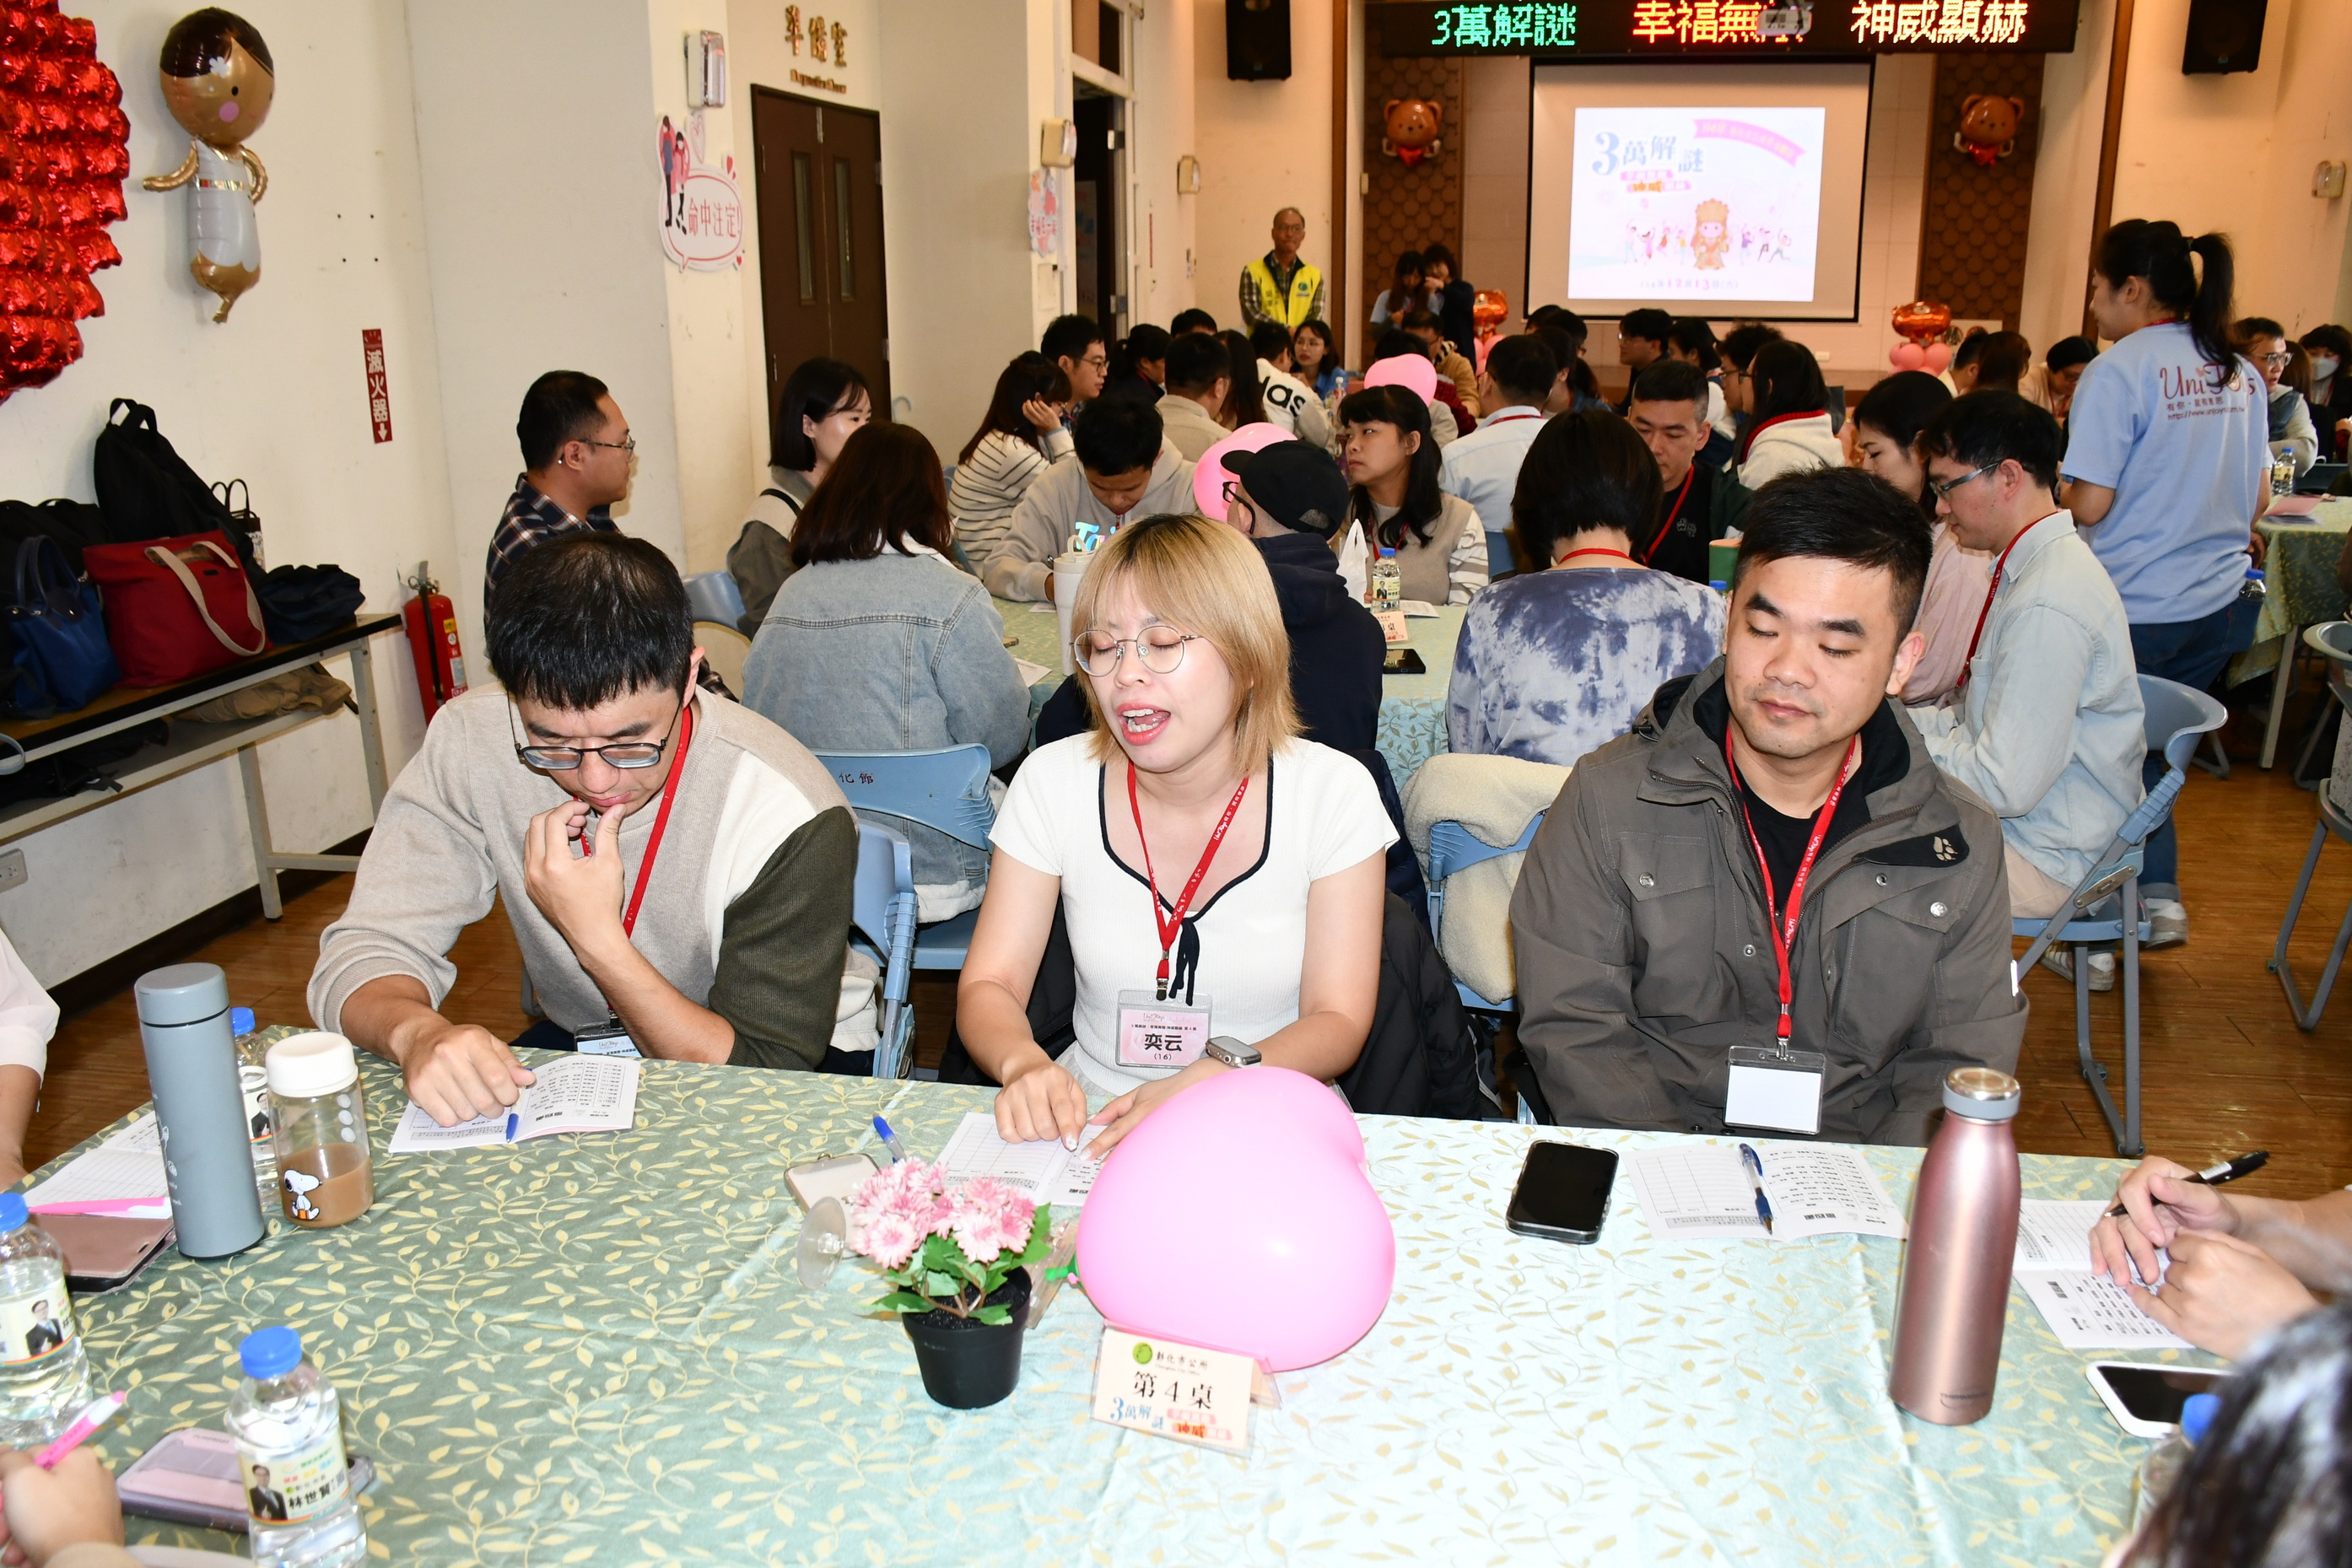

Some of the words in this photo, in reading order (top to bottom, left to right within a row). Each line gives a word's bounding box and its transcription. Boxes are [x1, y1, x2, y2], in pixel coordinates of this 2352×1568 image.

[1432, 3, 1576, 47] 3萬解謎
[1632, 0, 1804, 43] 幸福無
[1851, 0, 2028, 43] 神威顯赫
[1592, 132, 1704, 175] 3萬解謎
[366, 348, 388, 423] 滅火器
[1144, 1033, 1182, 1052] 奕云
[1110, 1397, 1164, 1430] 3萬解謎
[289, 1482, 330, 1510] 林世賢
